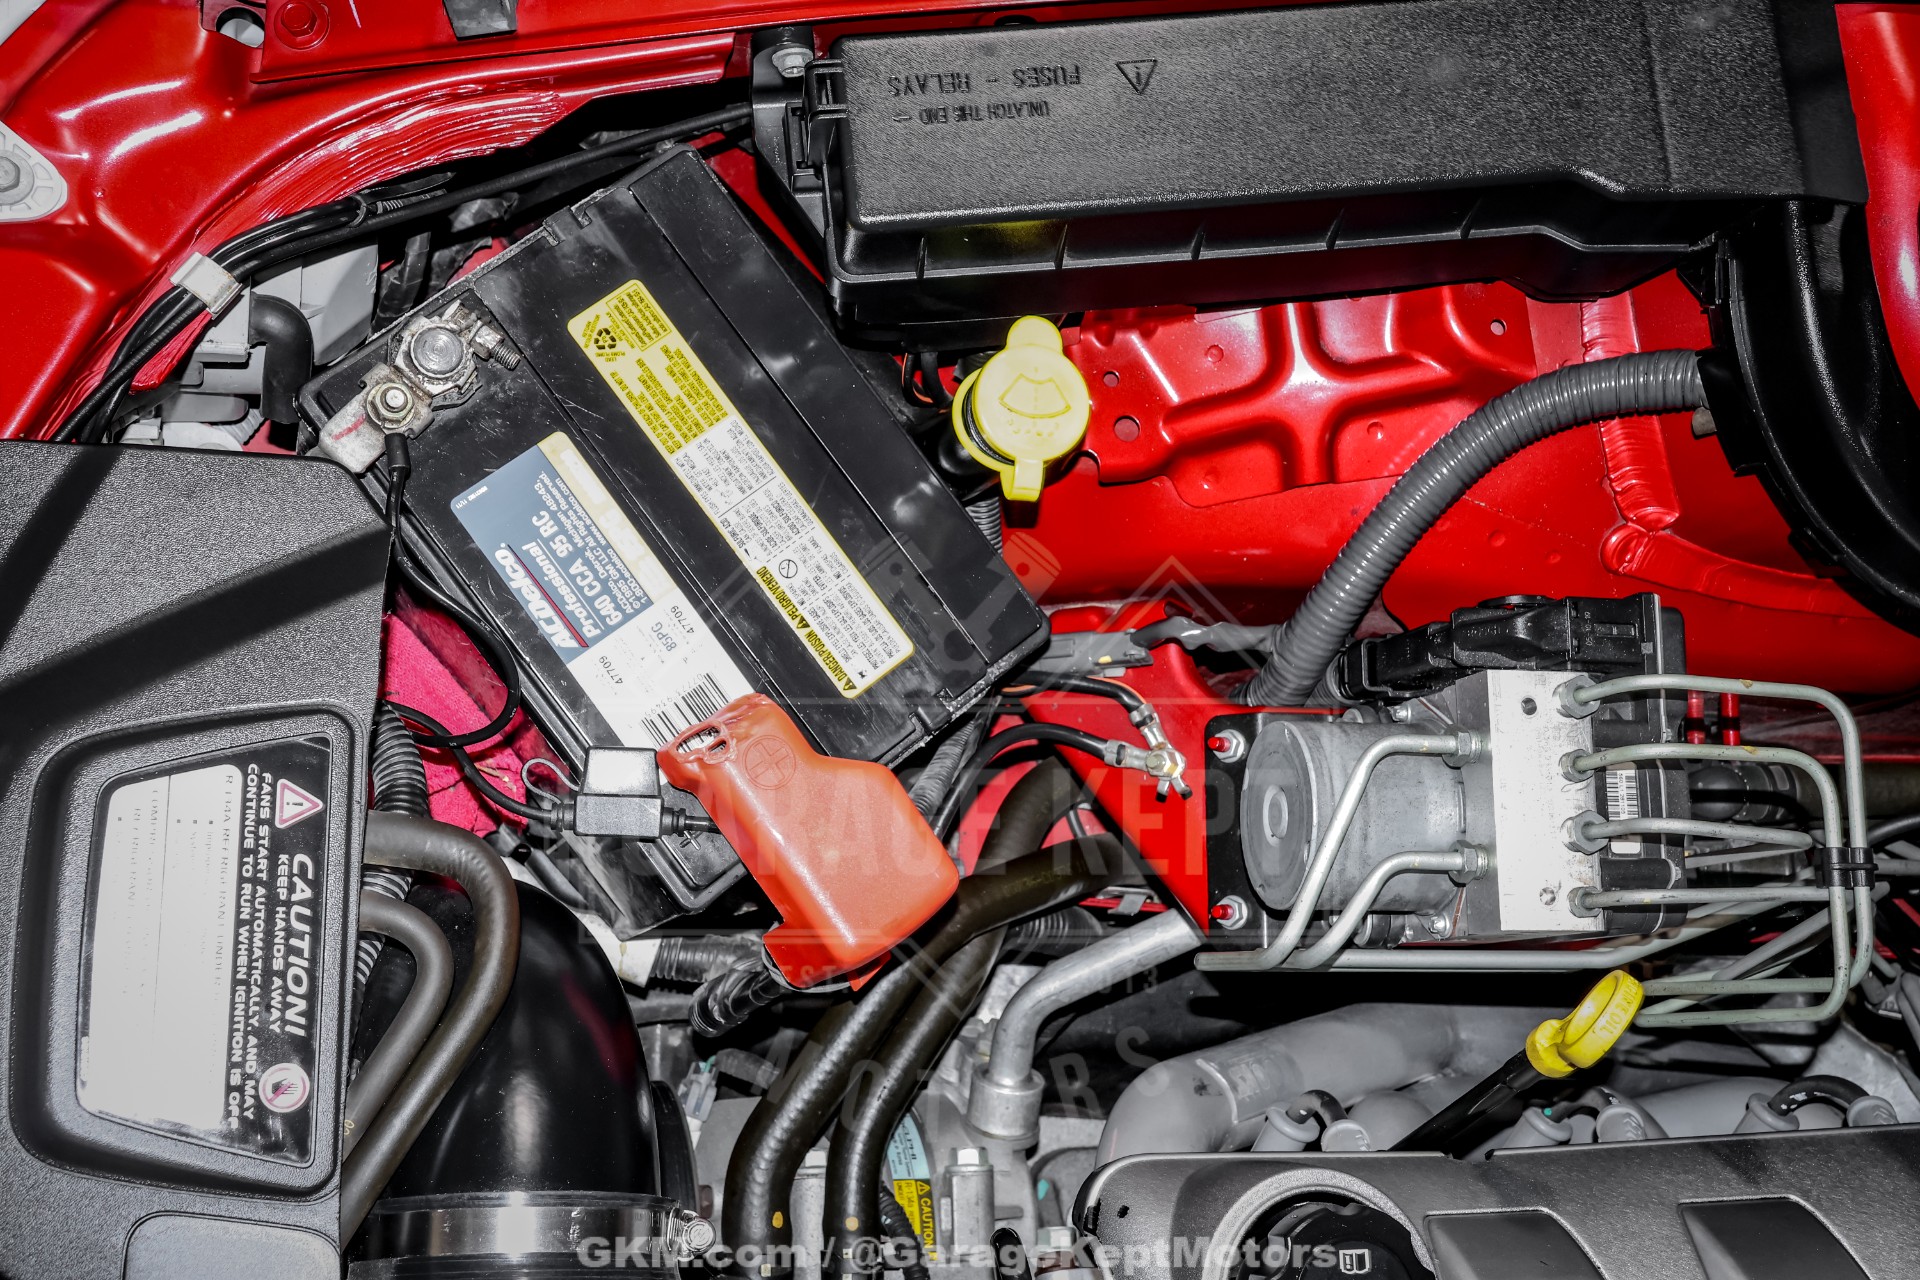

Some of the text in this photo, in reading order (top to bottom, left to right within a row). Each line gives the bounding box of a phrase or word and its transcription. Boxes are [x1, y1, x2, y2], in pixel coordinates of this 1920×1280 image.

[888, 72, 970, 97] RELAYS
[1013, 64, 1080, 88] FUSES
[919, 100, 1049, 125] UNLATCH THIS END
[531, 478, 560, 512] 48243,
[536, 469, 569, 511] Reserved.
[552, 476, 608, 547] www.acdelco.com
[554, 508, 587, 548] Michigan
[564, 507, 589, 536] Rights
[583, 534, 597, 549] All
[592, 546, 608, 564] LLC
[529, 507, 624, 627] 640 CCA 95 RC
[580, 545, 608, 579] Detroit,
[604, 562, 620, 580] GM
[604, 546, 649, 604] 1-800-acdelco
[489, 543, 579, 657] ACDelco
[521, 537, 601, 640] Professional
[603, 576, 635, 615] ACDelco,
[755, 564, 802, 621] PELIGRO/VENENO
[650, 620, 678, 652] 85PG
[668, 603, 696, 636] 47709
[597, 653, 624, 686] 47709
[803, 628, 847, 682] DANGER/POISON
[226, 763, 260, 1130] CONTINUE TO RUN WHEN IGNITION IS OFF
[241, 772, 274, 1119] FANS START AUTOMATICALLY, AND MAY
[267, 853, 291, 1033] KEEP HANDS AWAY
[279, 852, 317, 1035] CAUTION!
[919, 1196, 934, 1249] CAUTION
